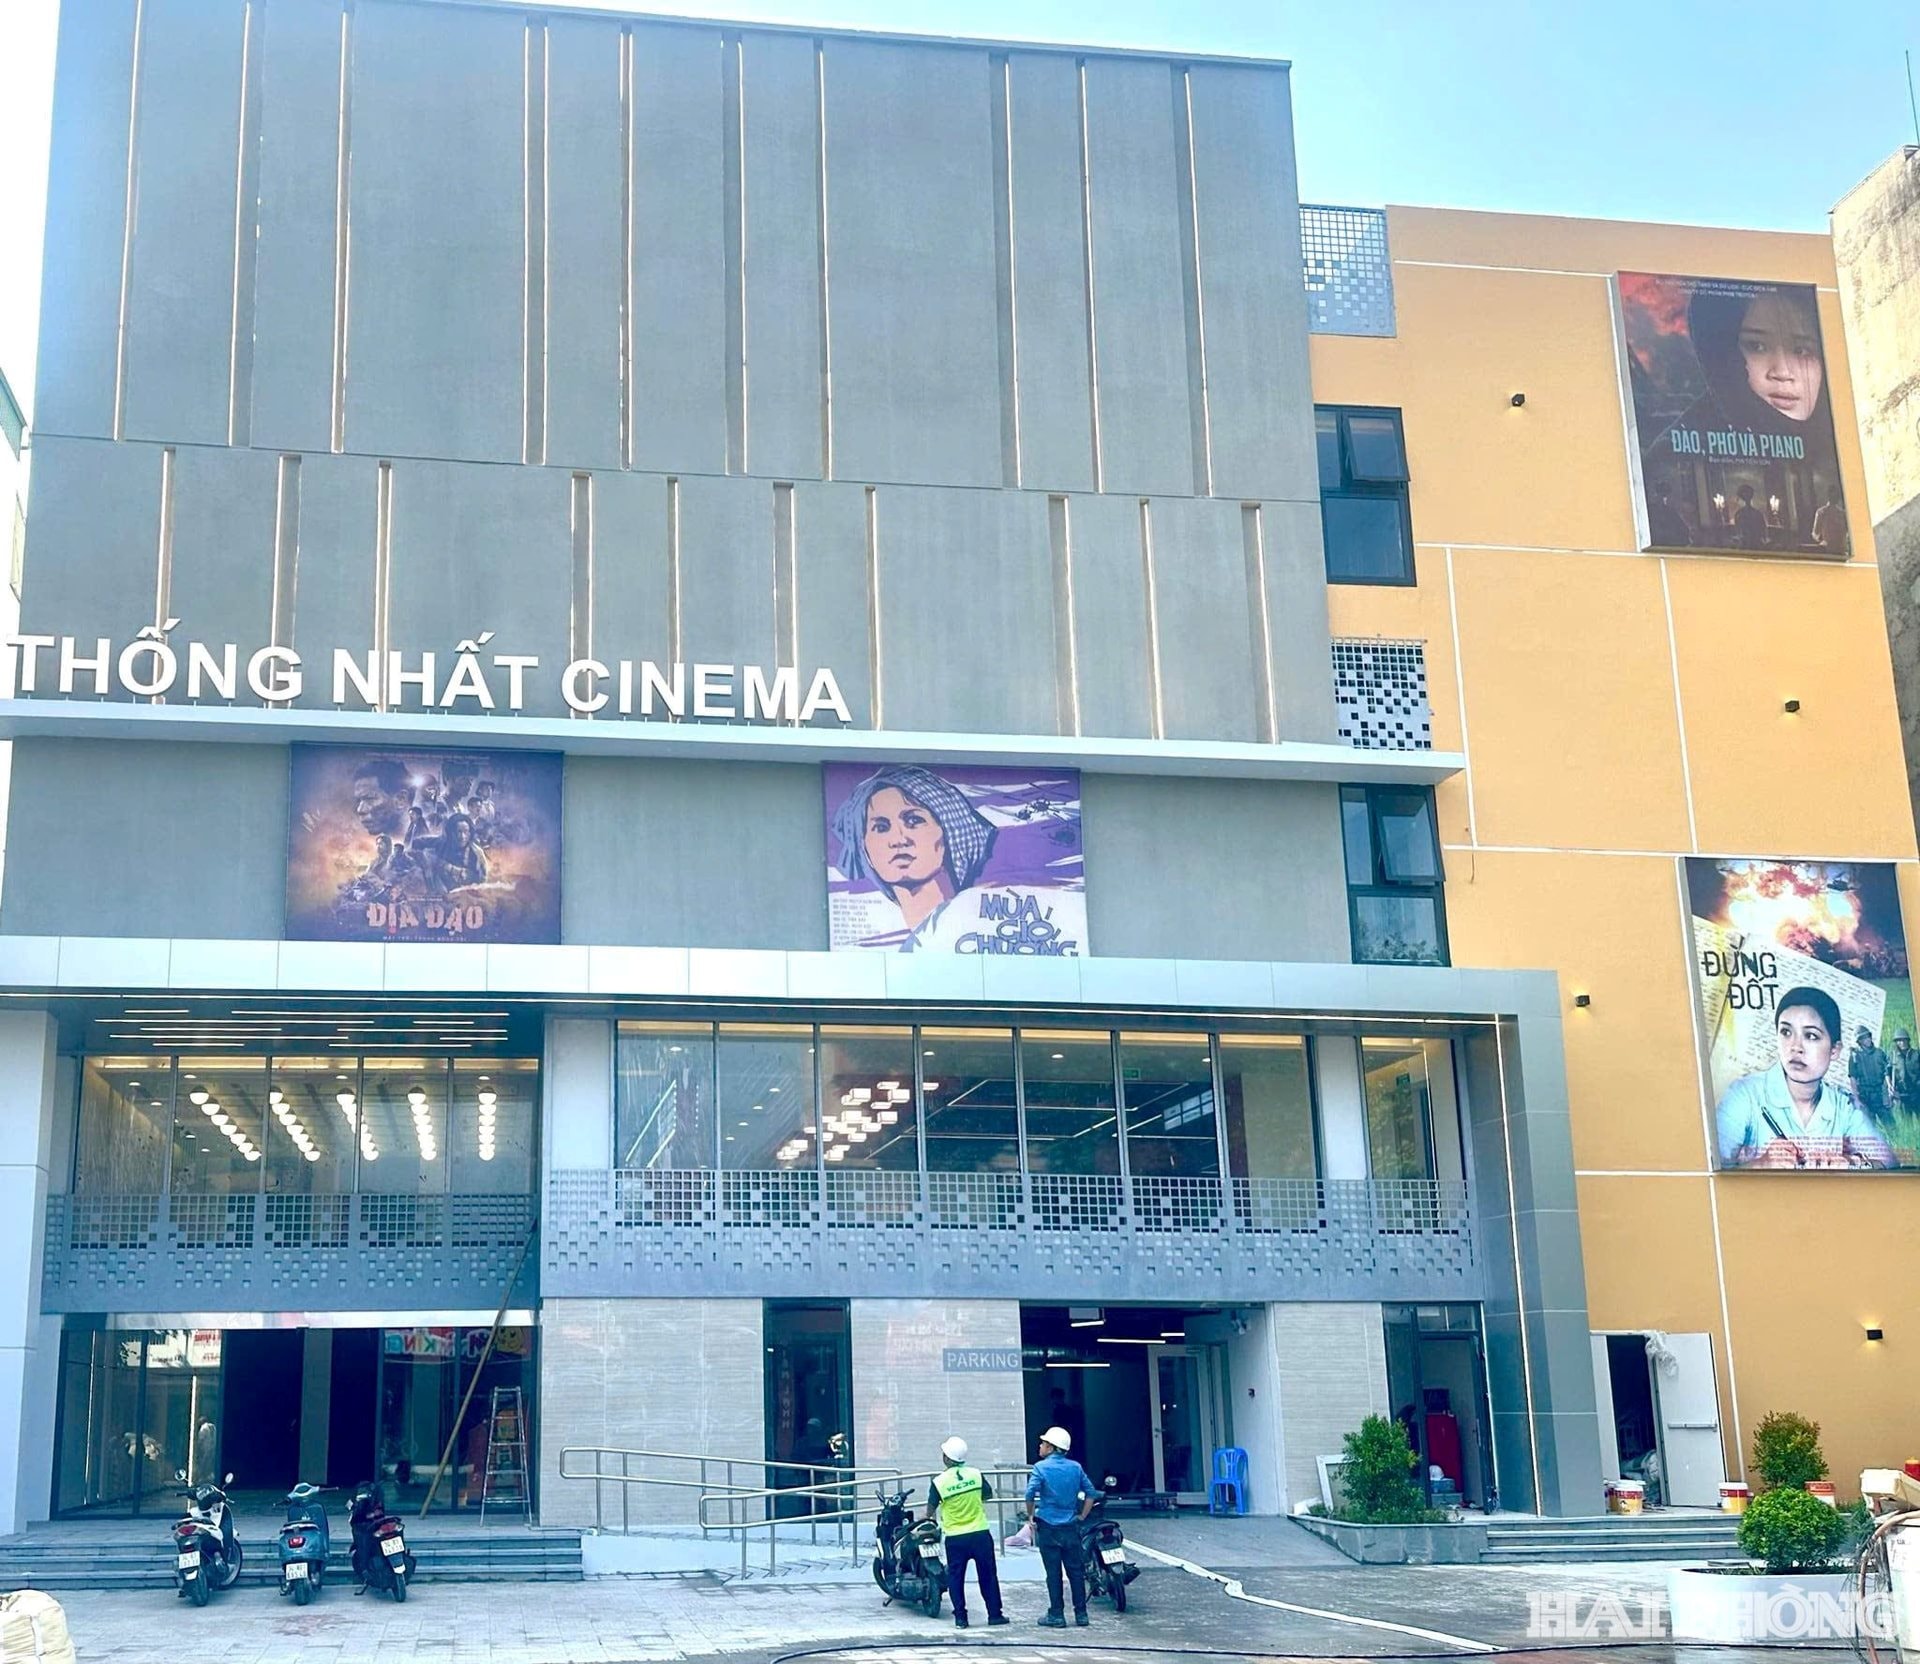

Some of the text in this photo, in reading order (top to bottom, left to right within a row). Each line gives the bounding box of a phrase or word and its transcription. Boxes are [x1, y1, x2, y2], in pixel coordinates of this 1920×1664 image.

[1671, 423, 1805, 460] ĐÀO, PHỞ VÀ PIANO
[7, 618, 852, 722] THỐNG NHẤT CINEMA
[979, 887, 1043, 921] MÙA
[996, 906, 1054, 944] GIÓ
[1726, 977, 1779, 1010] ĐỐT
[947, 1352, 1019, 1368] PARKING
